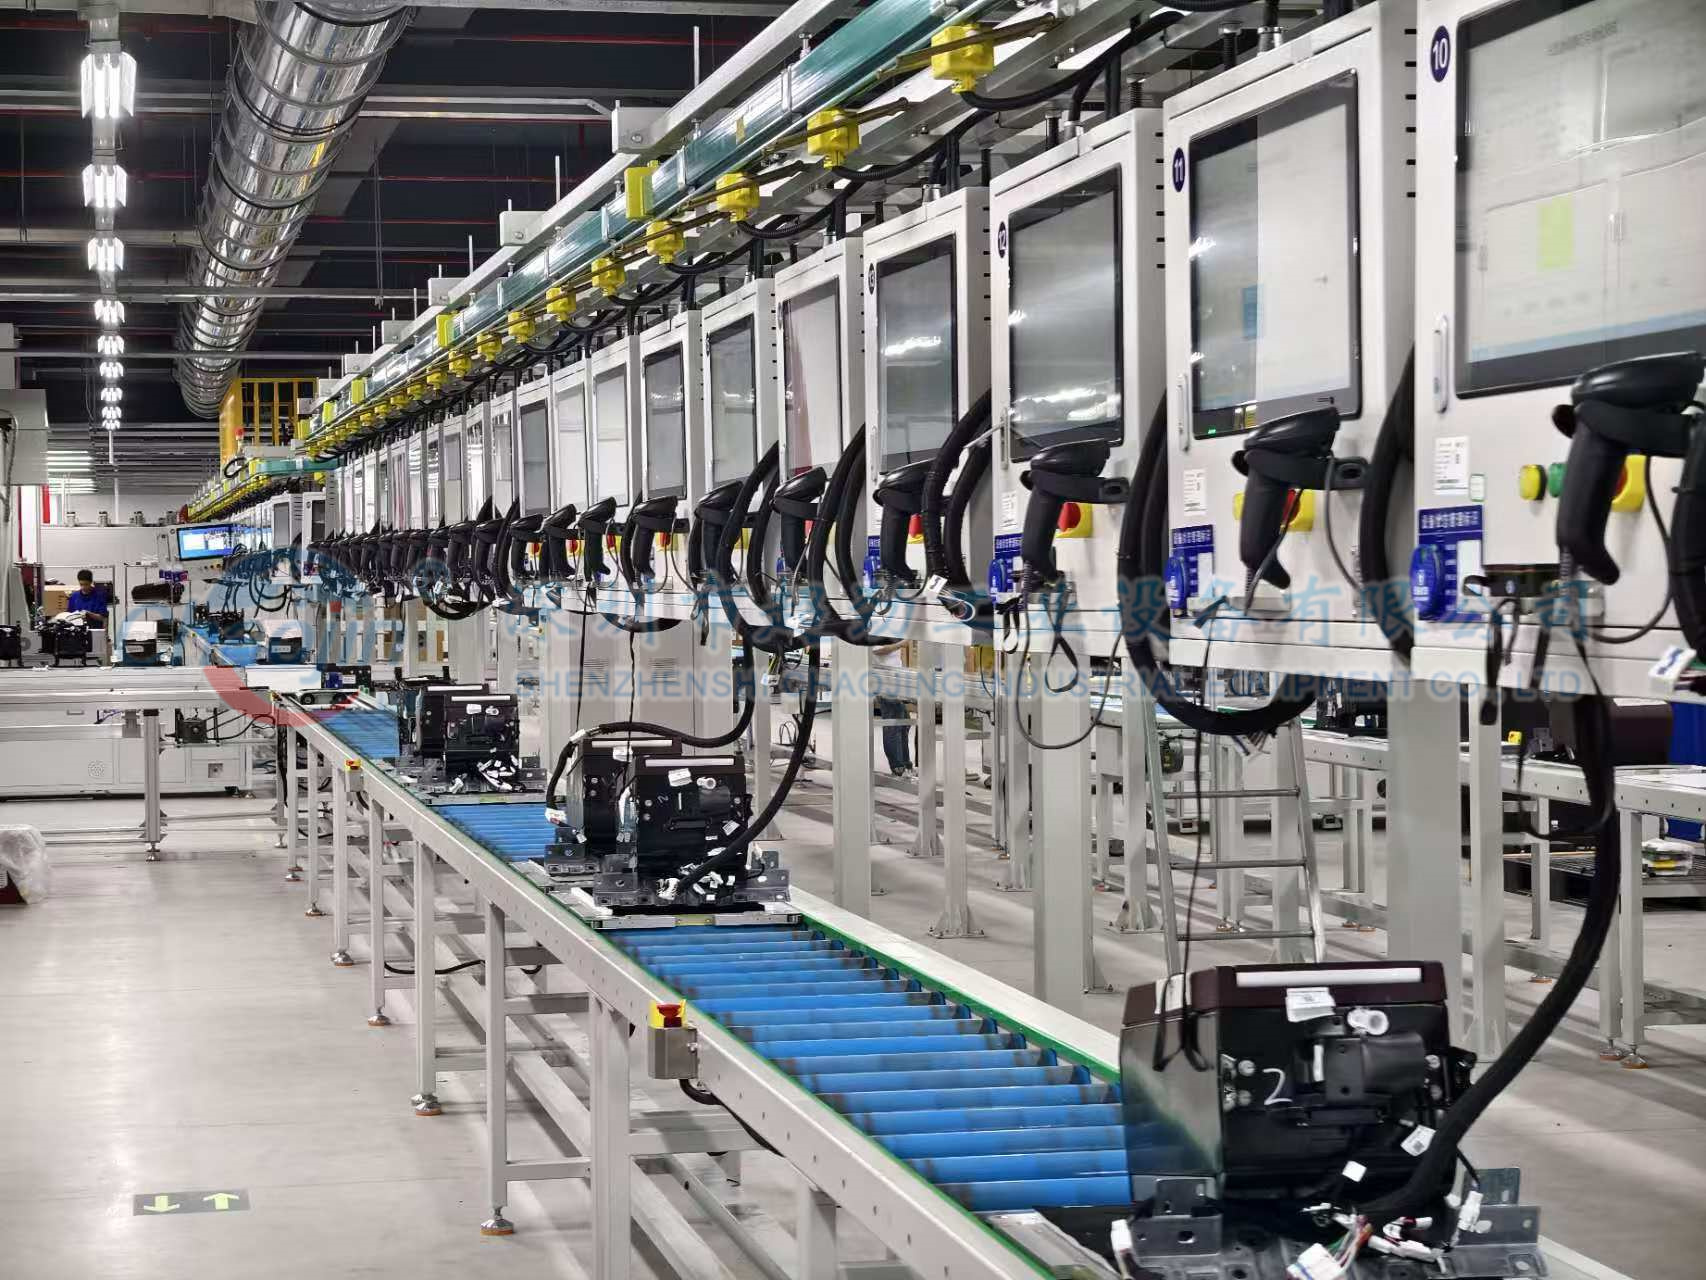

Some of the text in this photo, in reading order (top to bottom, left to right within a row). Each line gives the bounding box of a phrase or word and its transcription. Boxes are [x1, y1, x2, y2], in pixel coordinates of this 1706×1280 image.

[1432, 38, 1449, 70] 10
[1174, 157, 1184, 182] 11
[998, 229, 1006, 250] 12
[1262, 1067, 1293, 1106] 2
